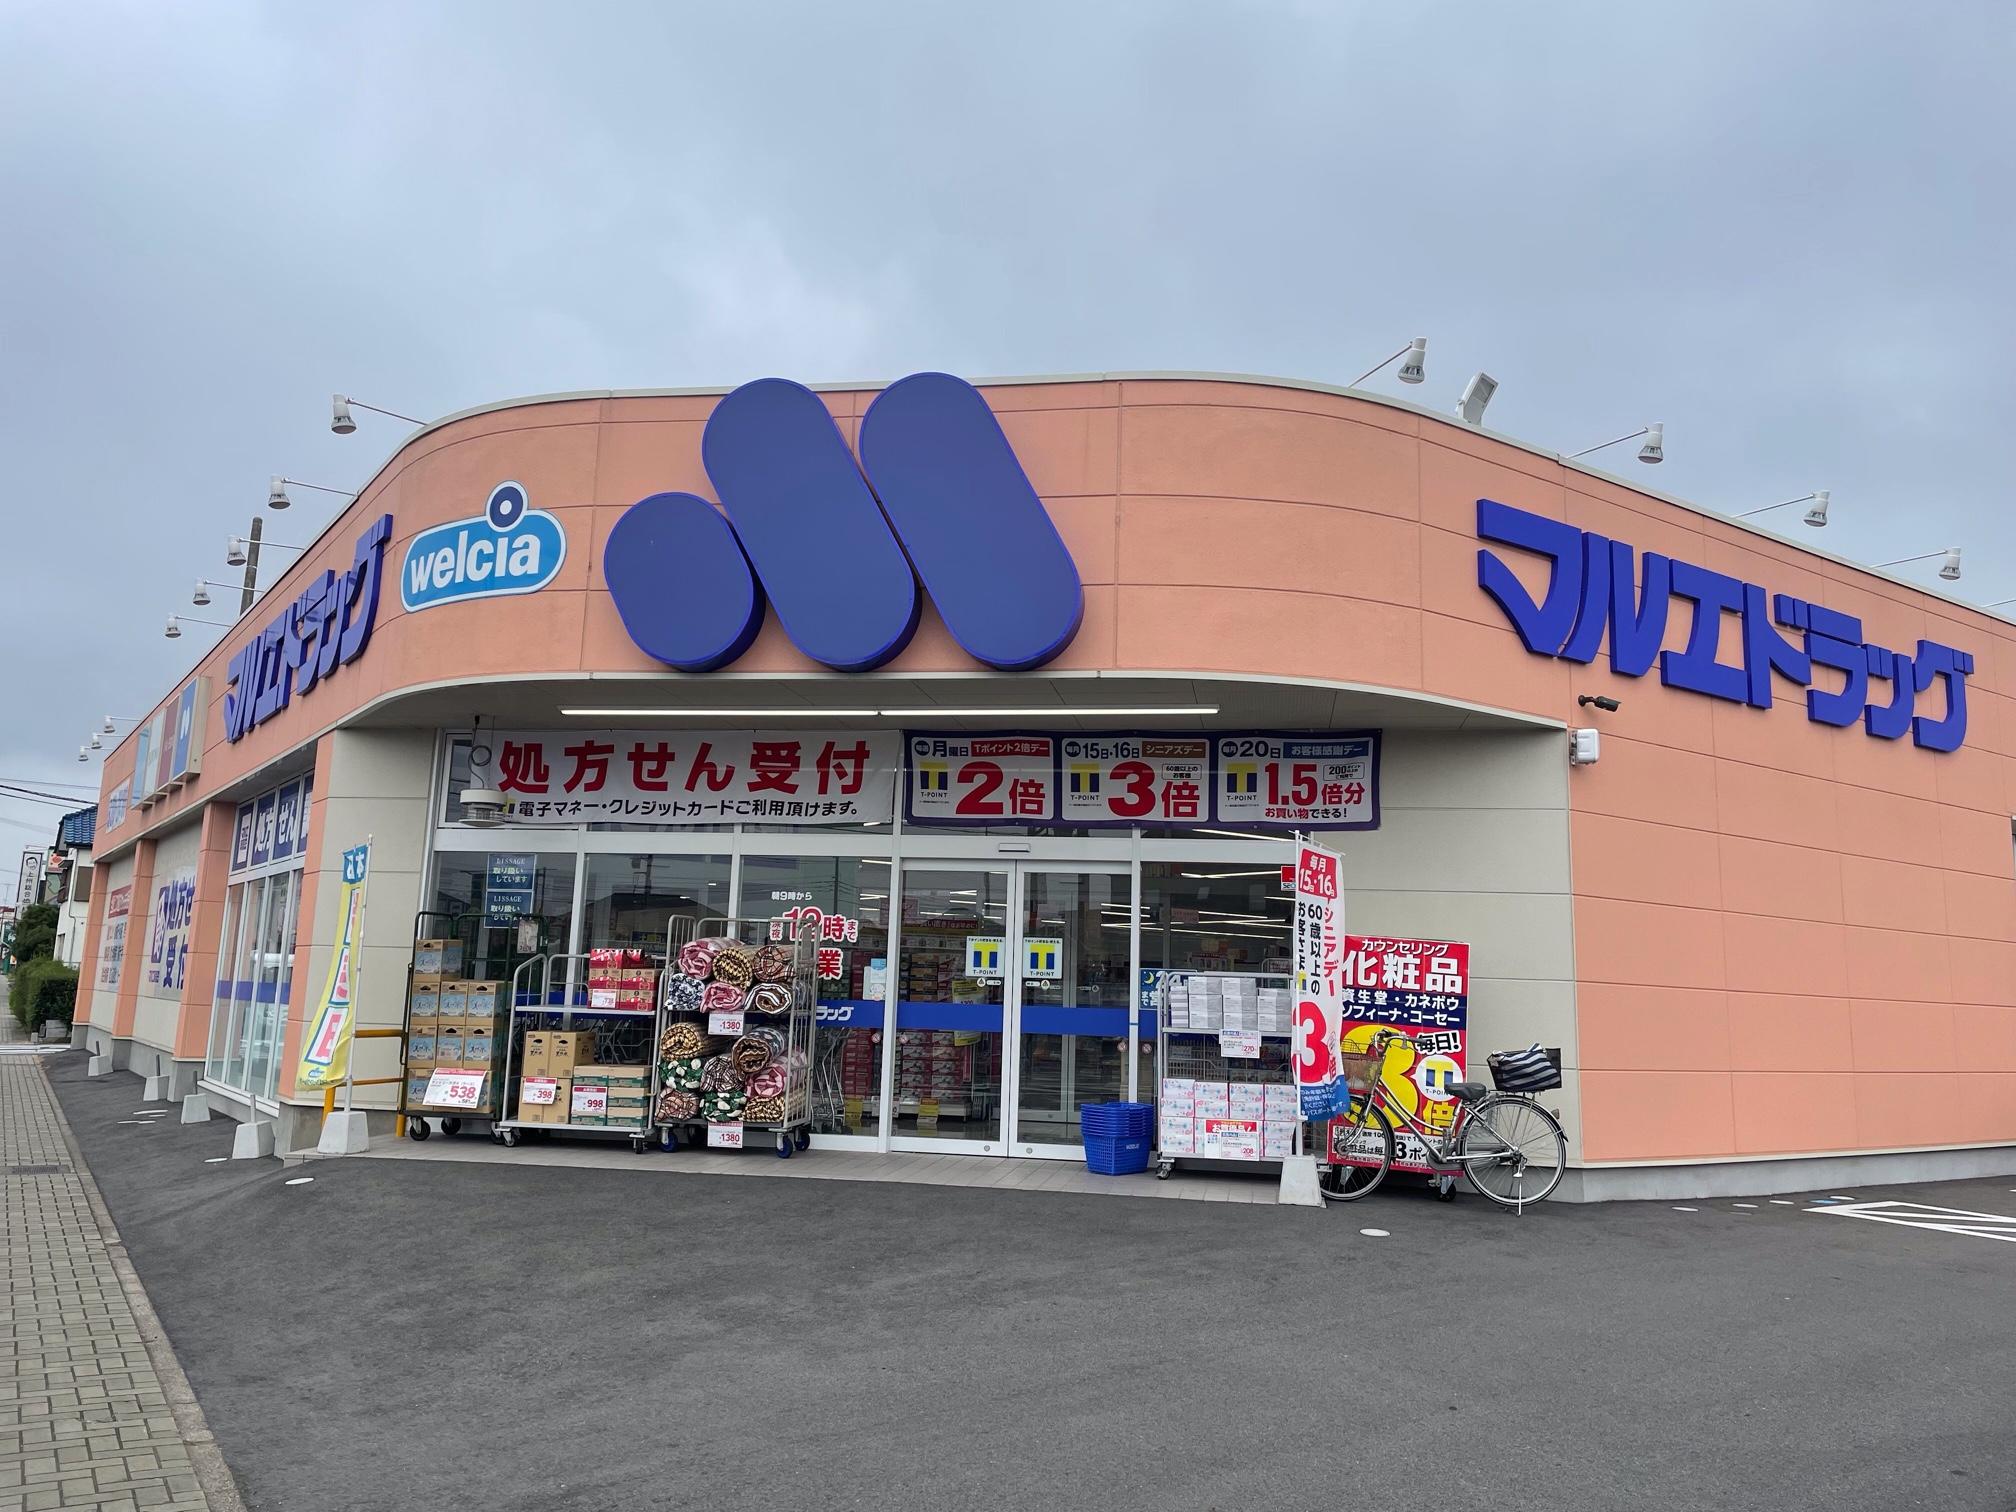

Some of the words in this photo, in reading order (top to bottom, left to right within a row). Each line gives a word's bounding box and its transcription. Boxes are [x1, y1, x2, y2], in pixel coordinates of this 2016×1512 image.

[410, 530, 541, 595] welcia
[224, 513, 394, 744] マルエドラッグ
[1477, 498, 1974, 754] マルエドラッグ
[932, 740, 969, 757] 月曜日
[974, 742, 1049, 753] Tポイント2倍デー
[1146, 744, 1203, 755] シニアズデー
[1240, 741, 1281, 759] 20日
[498, 739, 871, 795] 処方せん受付
[1264, 763, 1365, 806] 1.5倍分
[518, 799, 858, 818] 電子マネー・クレジットカードご利用頂けます。
[1310, 855, 1327, 872] 毎月
[1308, 904, 1323, 996] 60歳以上の
[1324, 907, 1338, 997] シニアデー
[1362, 939, 1449, 956] カウンセリング
[1342, 950, 1463, 994] 化粧品
[1342, 988, 1459, 1011] 資生堂・カネボウ
[1342, 1005, 1460, 1026] ソフィーナ・コーセー
[722, 1020, 741, 1030] 1380
[450, 1086, 476, 1099] 538
[537, 1090, 553, 1099] 398
[1425, 1088, 1450, 1096] T-POIN
[587, 1099, 604, 1108] 998
[721, 1133, 740, 1142] 1380
